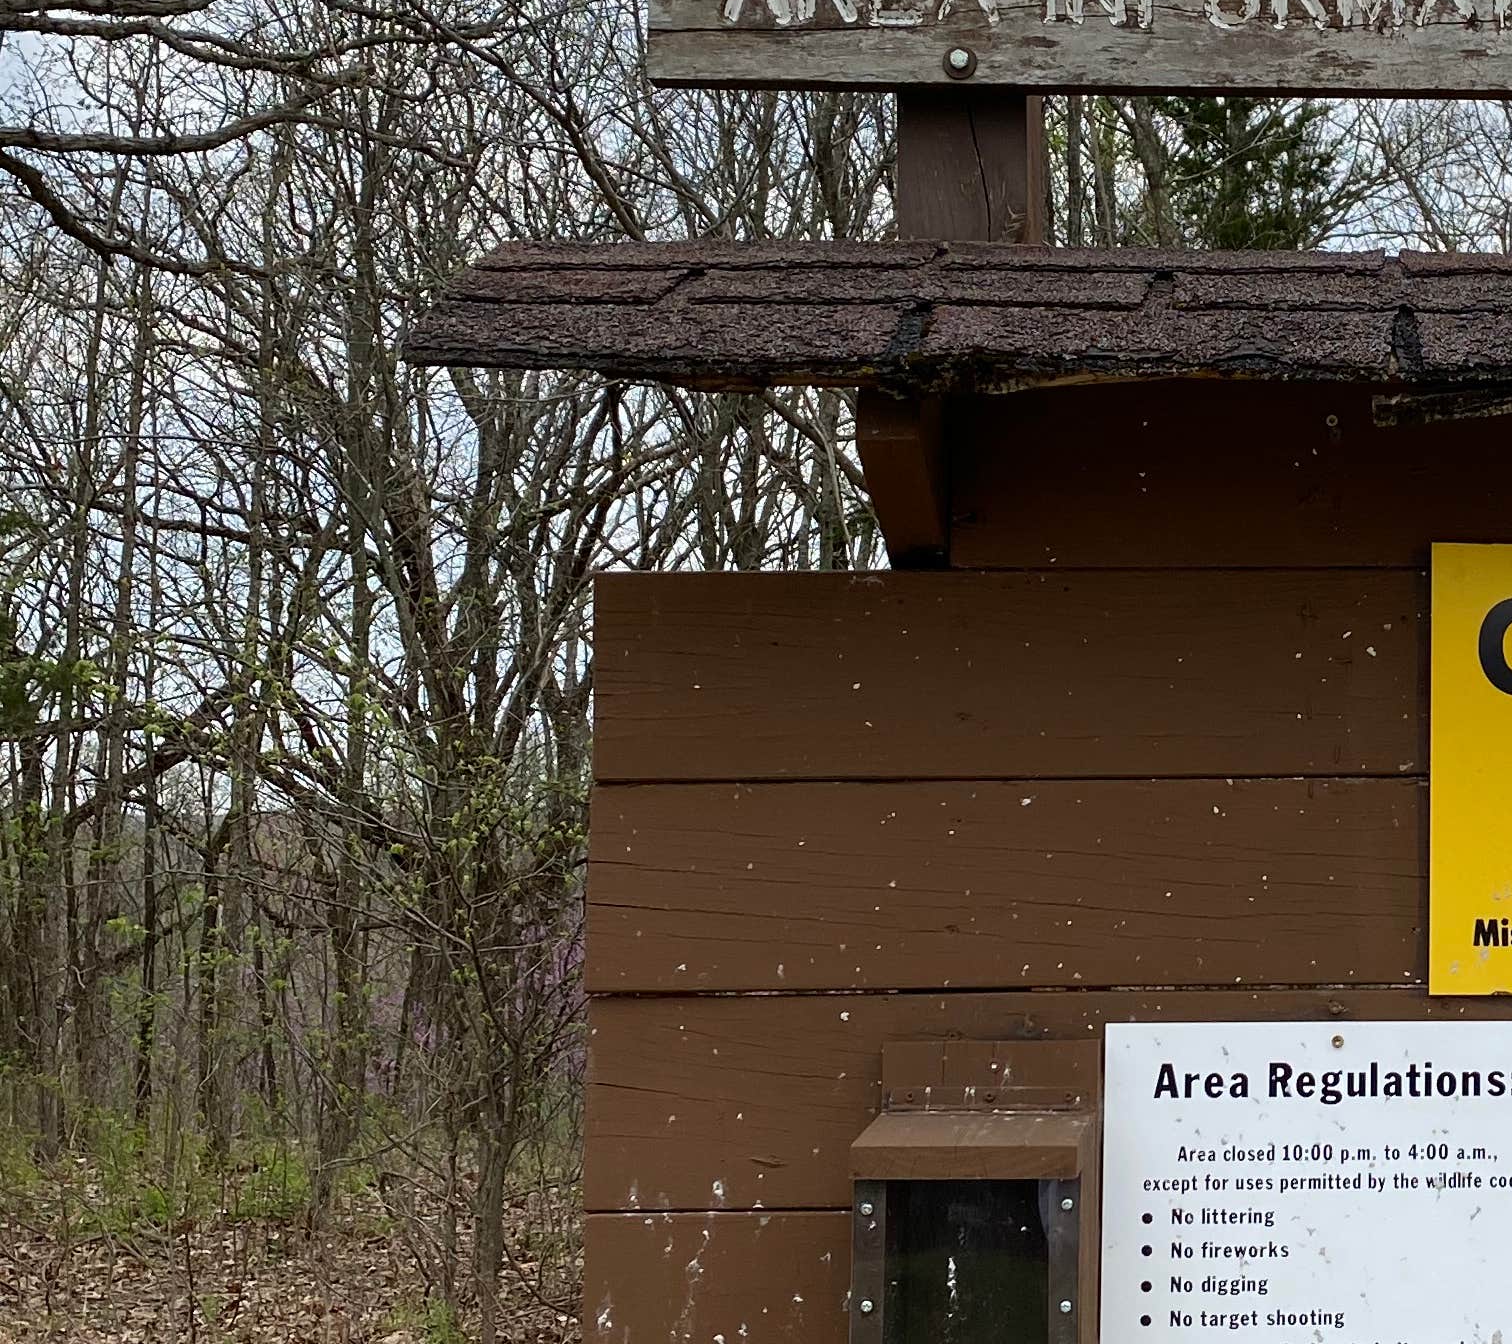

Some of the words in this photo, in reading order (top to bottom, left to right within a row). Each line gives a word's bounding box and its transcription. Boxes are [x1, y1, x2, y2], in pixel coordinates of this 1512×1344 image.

[1154, 1064, 1248, 1098] Area
[1178, 1146, 1215, 1161] Area
[1224, 1144, 1275, 1161] closed
[1283, 1144, 1332, 1161] 10:00
[1341, 1149, 1376, 1164] p.m.
[1385, 1145, 1400, 1160] to
[1409, 1144, 1448, 1160] 4:00
[1457, 1148, 1497, 1161] a.m.,
[1144, 1176, 1197, 1194] except
[1205, 1174, 1228, 1190] for
[1236, 1179, 1272, 1190] uses
[1280, 1173, 1361, 1193] permitted
[1369, 1173, 1385, 1192] by
[1394, 1173, 1418, 1188] the
[1426, 1172, 1481, 1188] wildlife
[1172, 1209, 1193, 1224] No
[1202, 1208, 1274, 1227] littering
[1172, 1243, 1193, 1258] No
[1201, 1242, 1288, 1258] fireworks
[1171, 1277, 1192, 1292] No
[1202, 1275, 1267, 1295] digging
[1170, 1311, 1192, 1327] No
[1201, 1311, 1257, 1329] target
[1267, 1309, 1344, 1328] shooting
